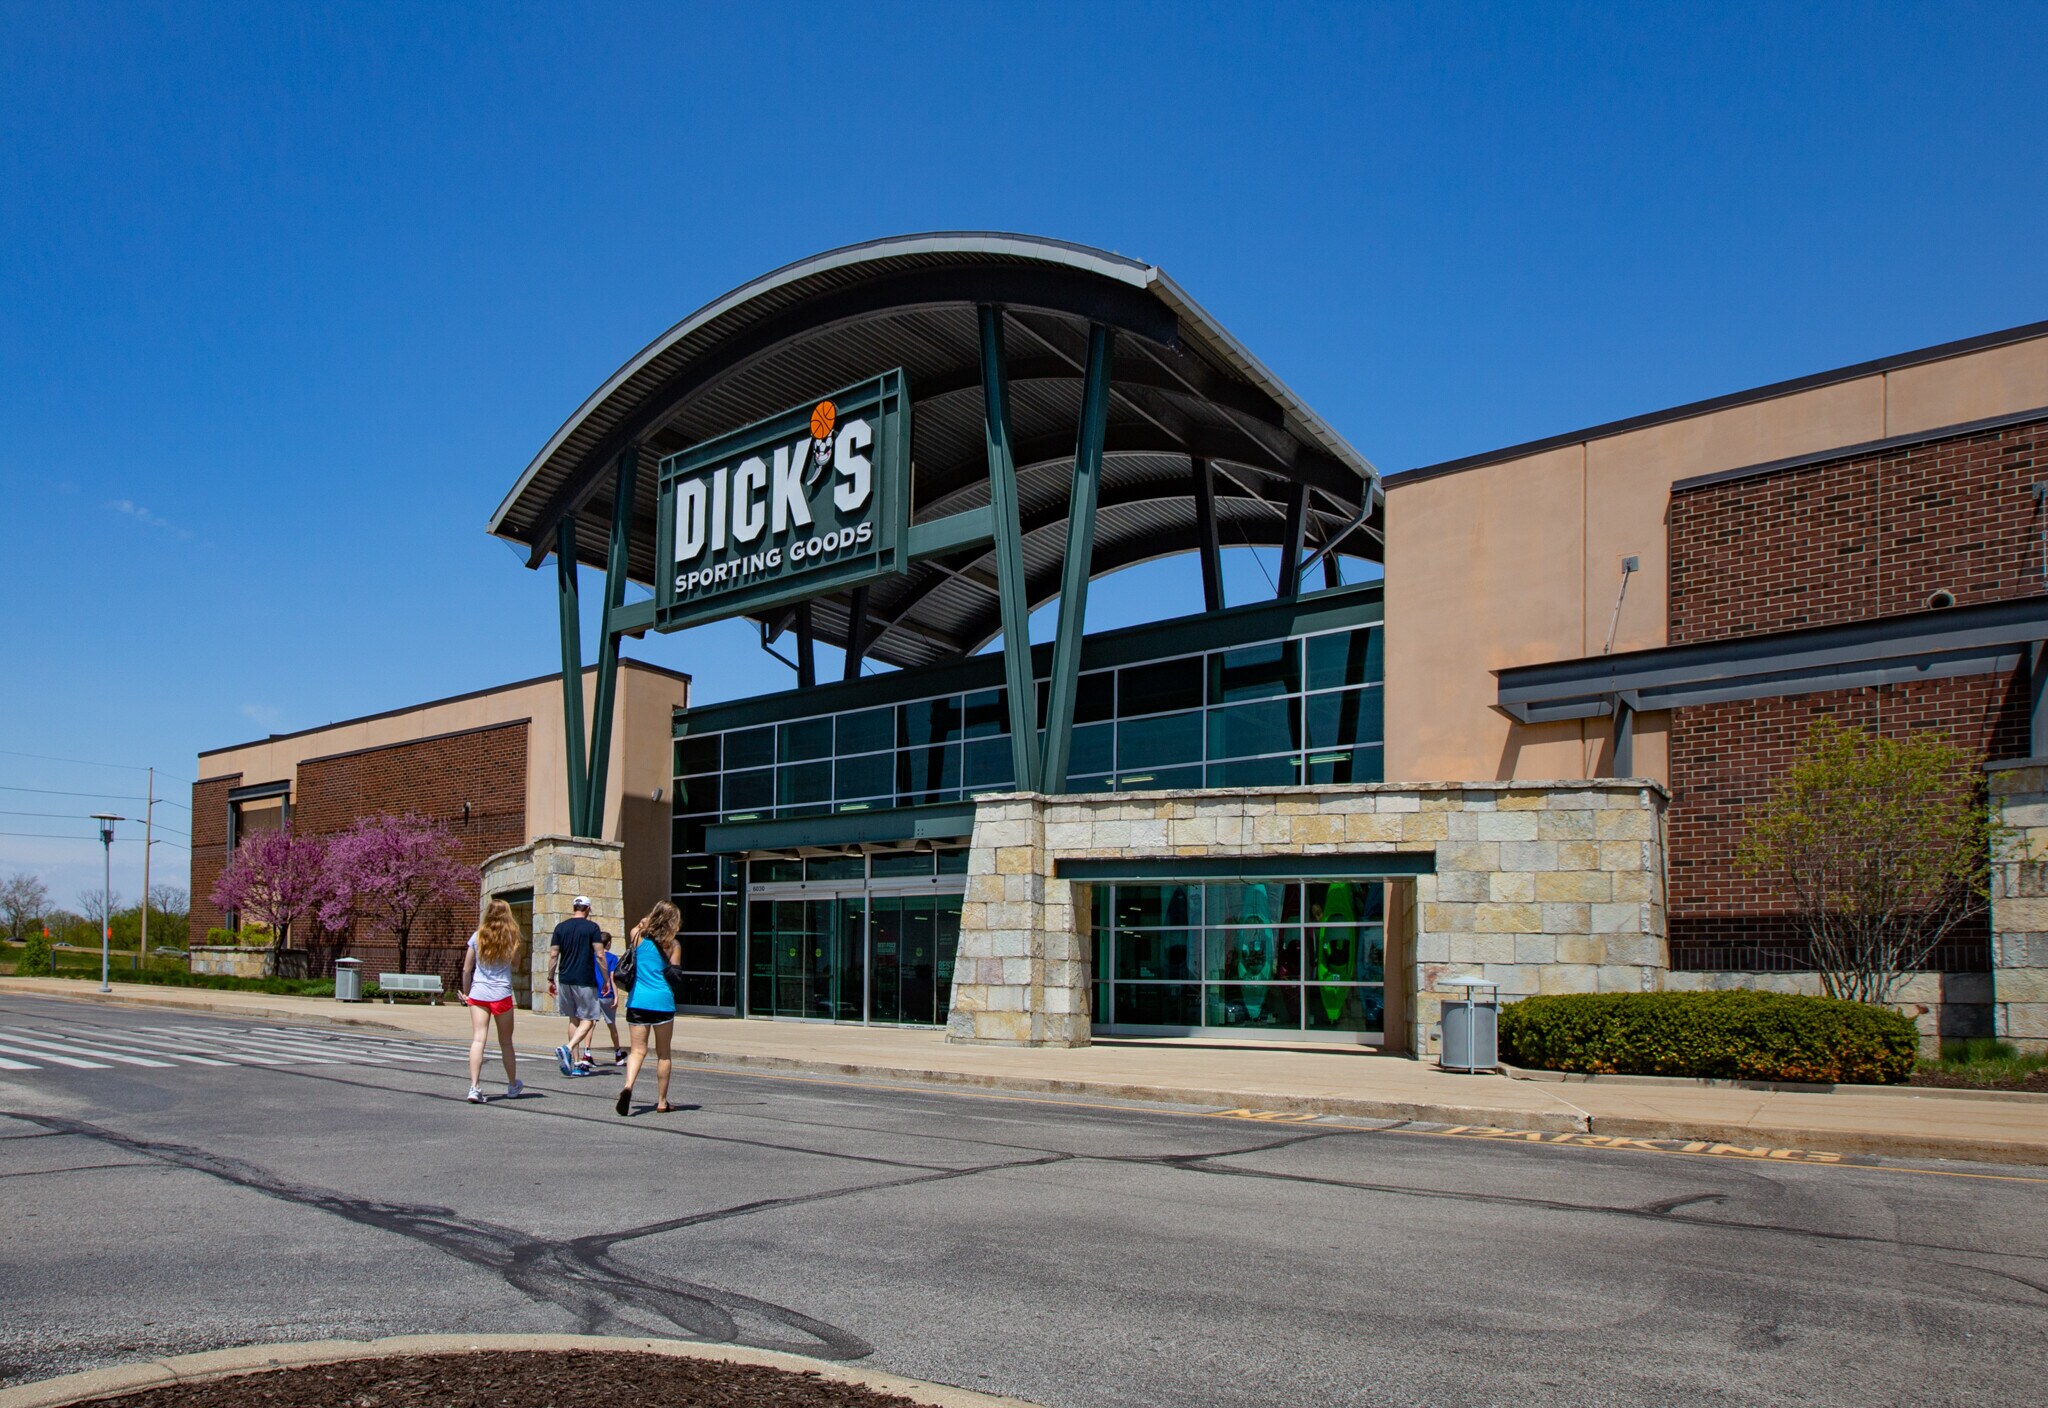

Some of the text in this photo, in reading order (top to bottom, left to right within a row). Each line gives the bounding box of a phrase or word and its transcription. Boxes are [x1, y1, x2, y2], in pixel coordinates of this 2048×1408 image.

[675, 418, 872, 563] DICK'S
[675, 521, 873, 593] SPORTING GOODS
[1444, 1126, 1841, 1162] PARKING
